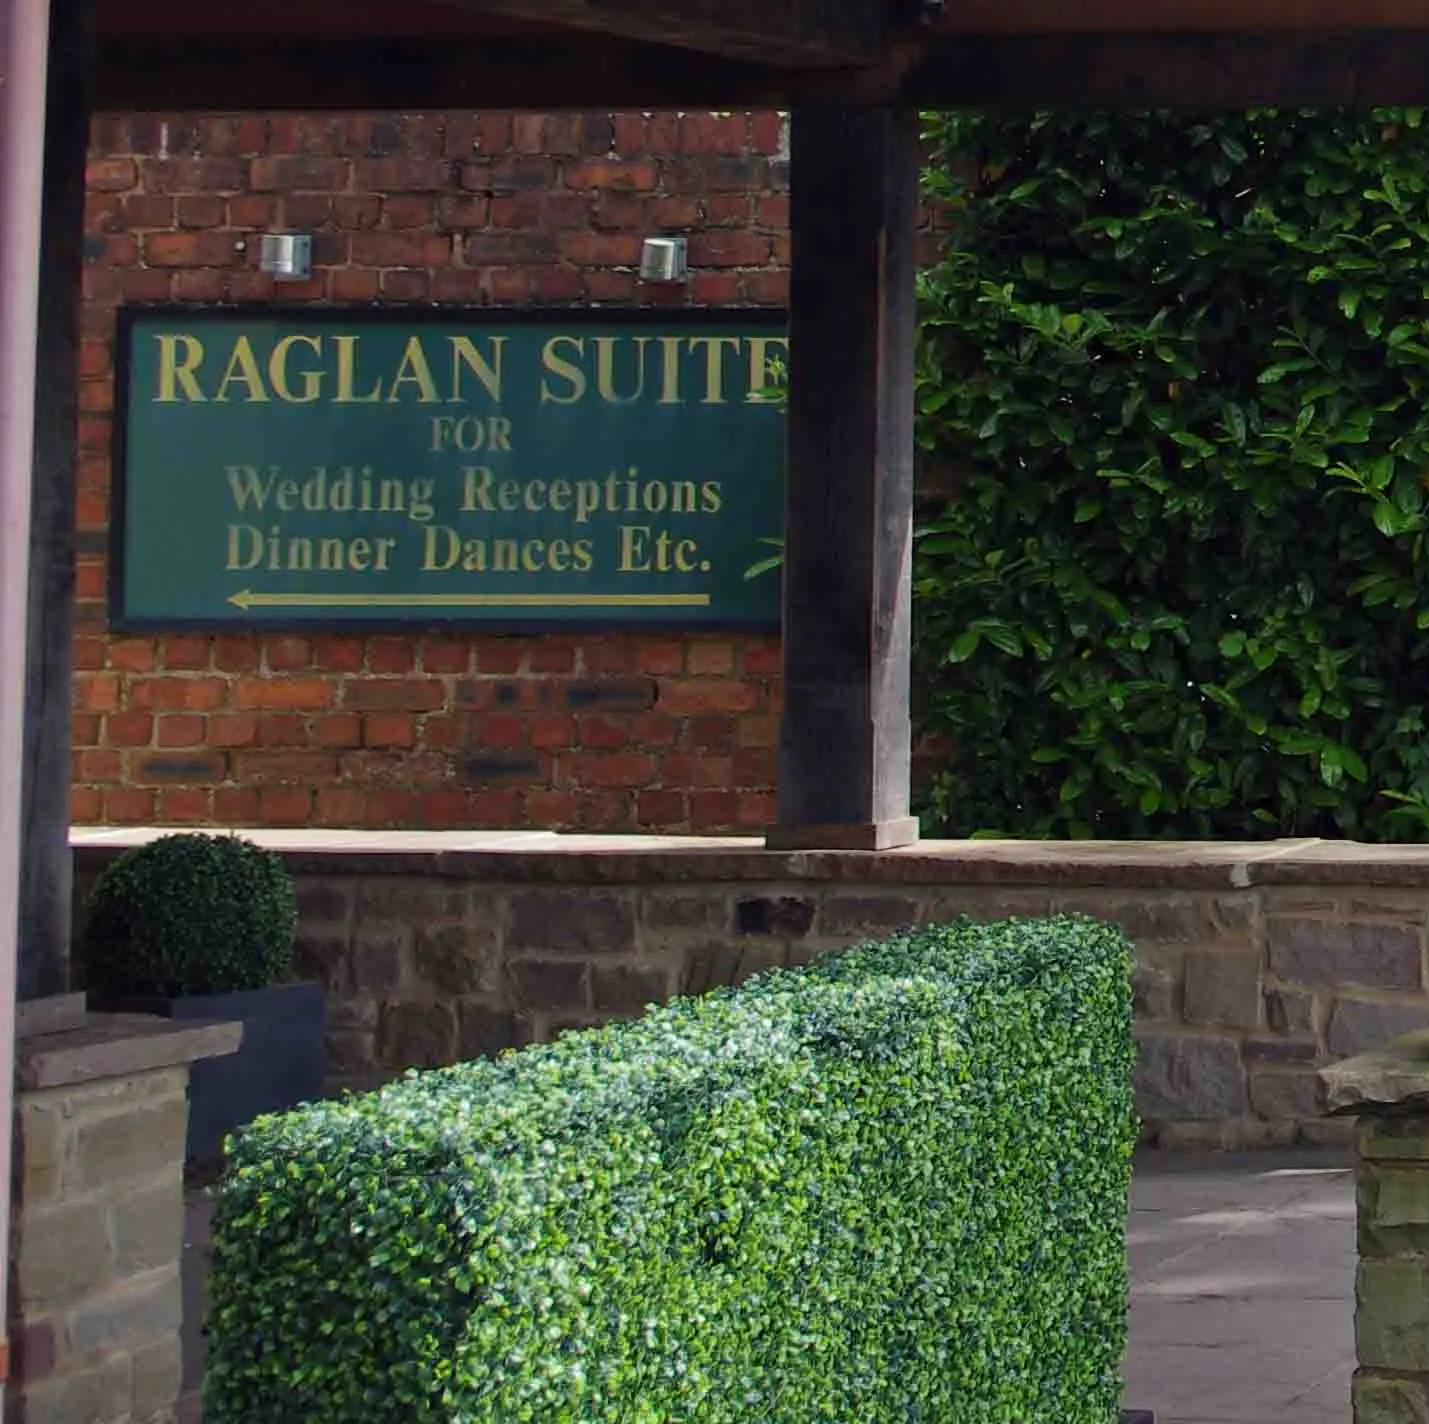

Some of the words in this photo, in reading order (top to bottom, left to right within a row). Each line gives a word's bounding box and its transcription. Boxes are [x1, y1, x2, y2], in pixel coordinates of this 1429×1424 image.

[151, 334, 510, 405] RAGLAN
[539, 334, 791, 405] SUITE
[428, 415, 514, 452] FOR
[224, 465, 436, 521] Wedding
[458, 466, 723, 524] Receptions
[224, 525, 396, 573] Dinner
[420, 525, 594, 573] Dances
[615, 525, 712, 573] Etc.
